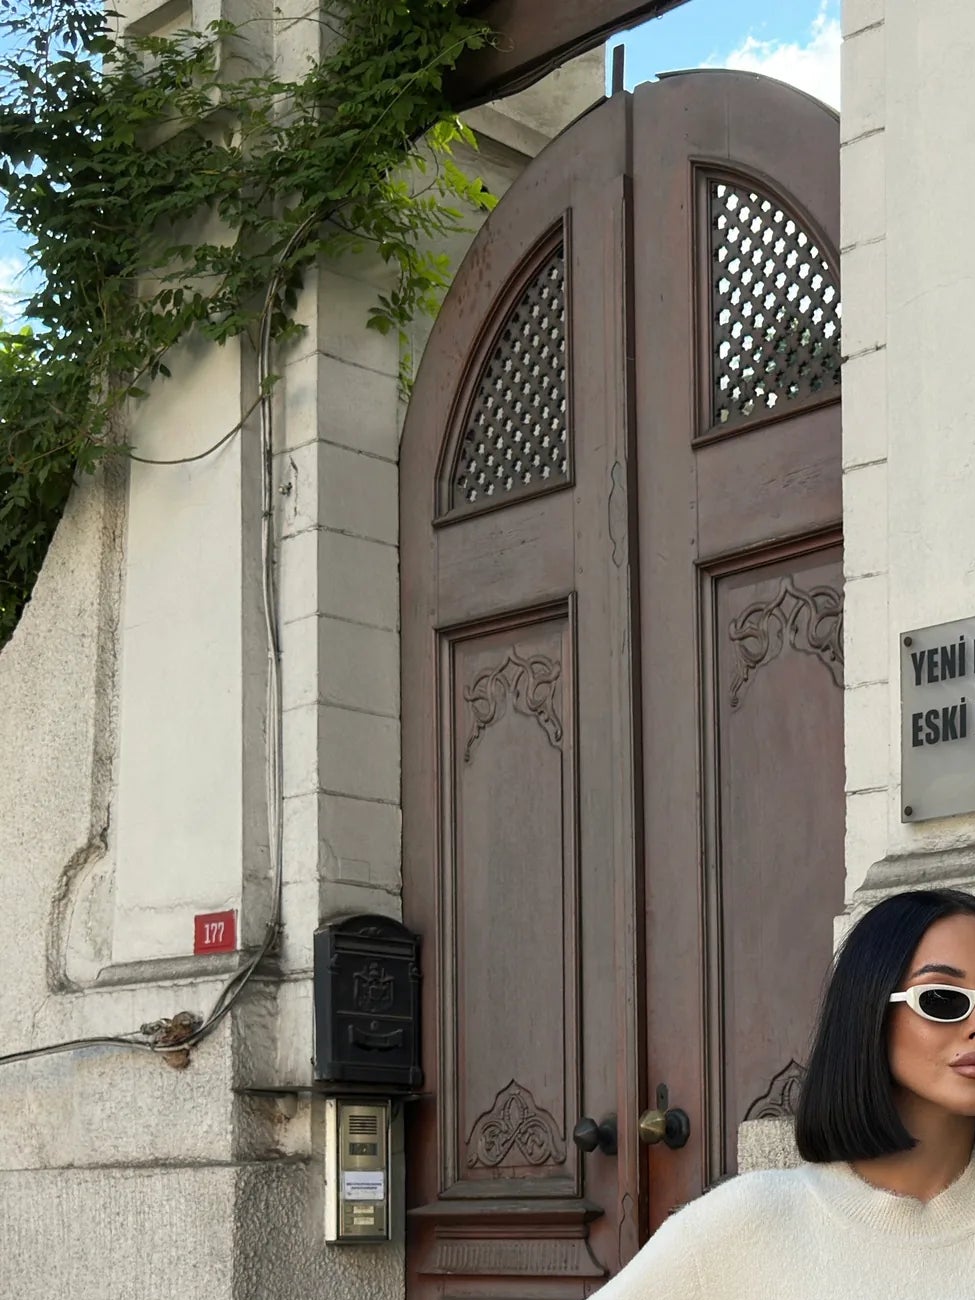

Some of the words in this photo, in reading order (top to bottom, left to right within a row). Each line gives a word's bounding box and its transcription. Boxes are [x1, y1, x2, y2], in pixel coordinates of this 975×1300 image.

[911, 636, 967, 687] YENİ
[911, 697, 967, 748] ESKİ
[204, 921, 225, 944] 177
